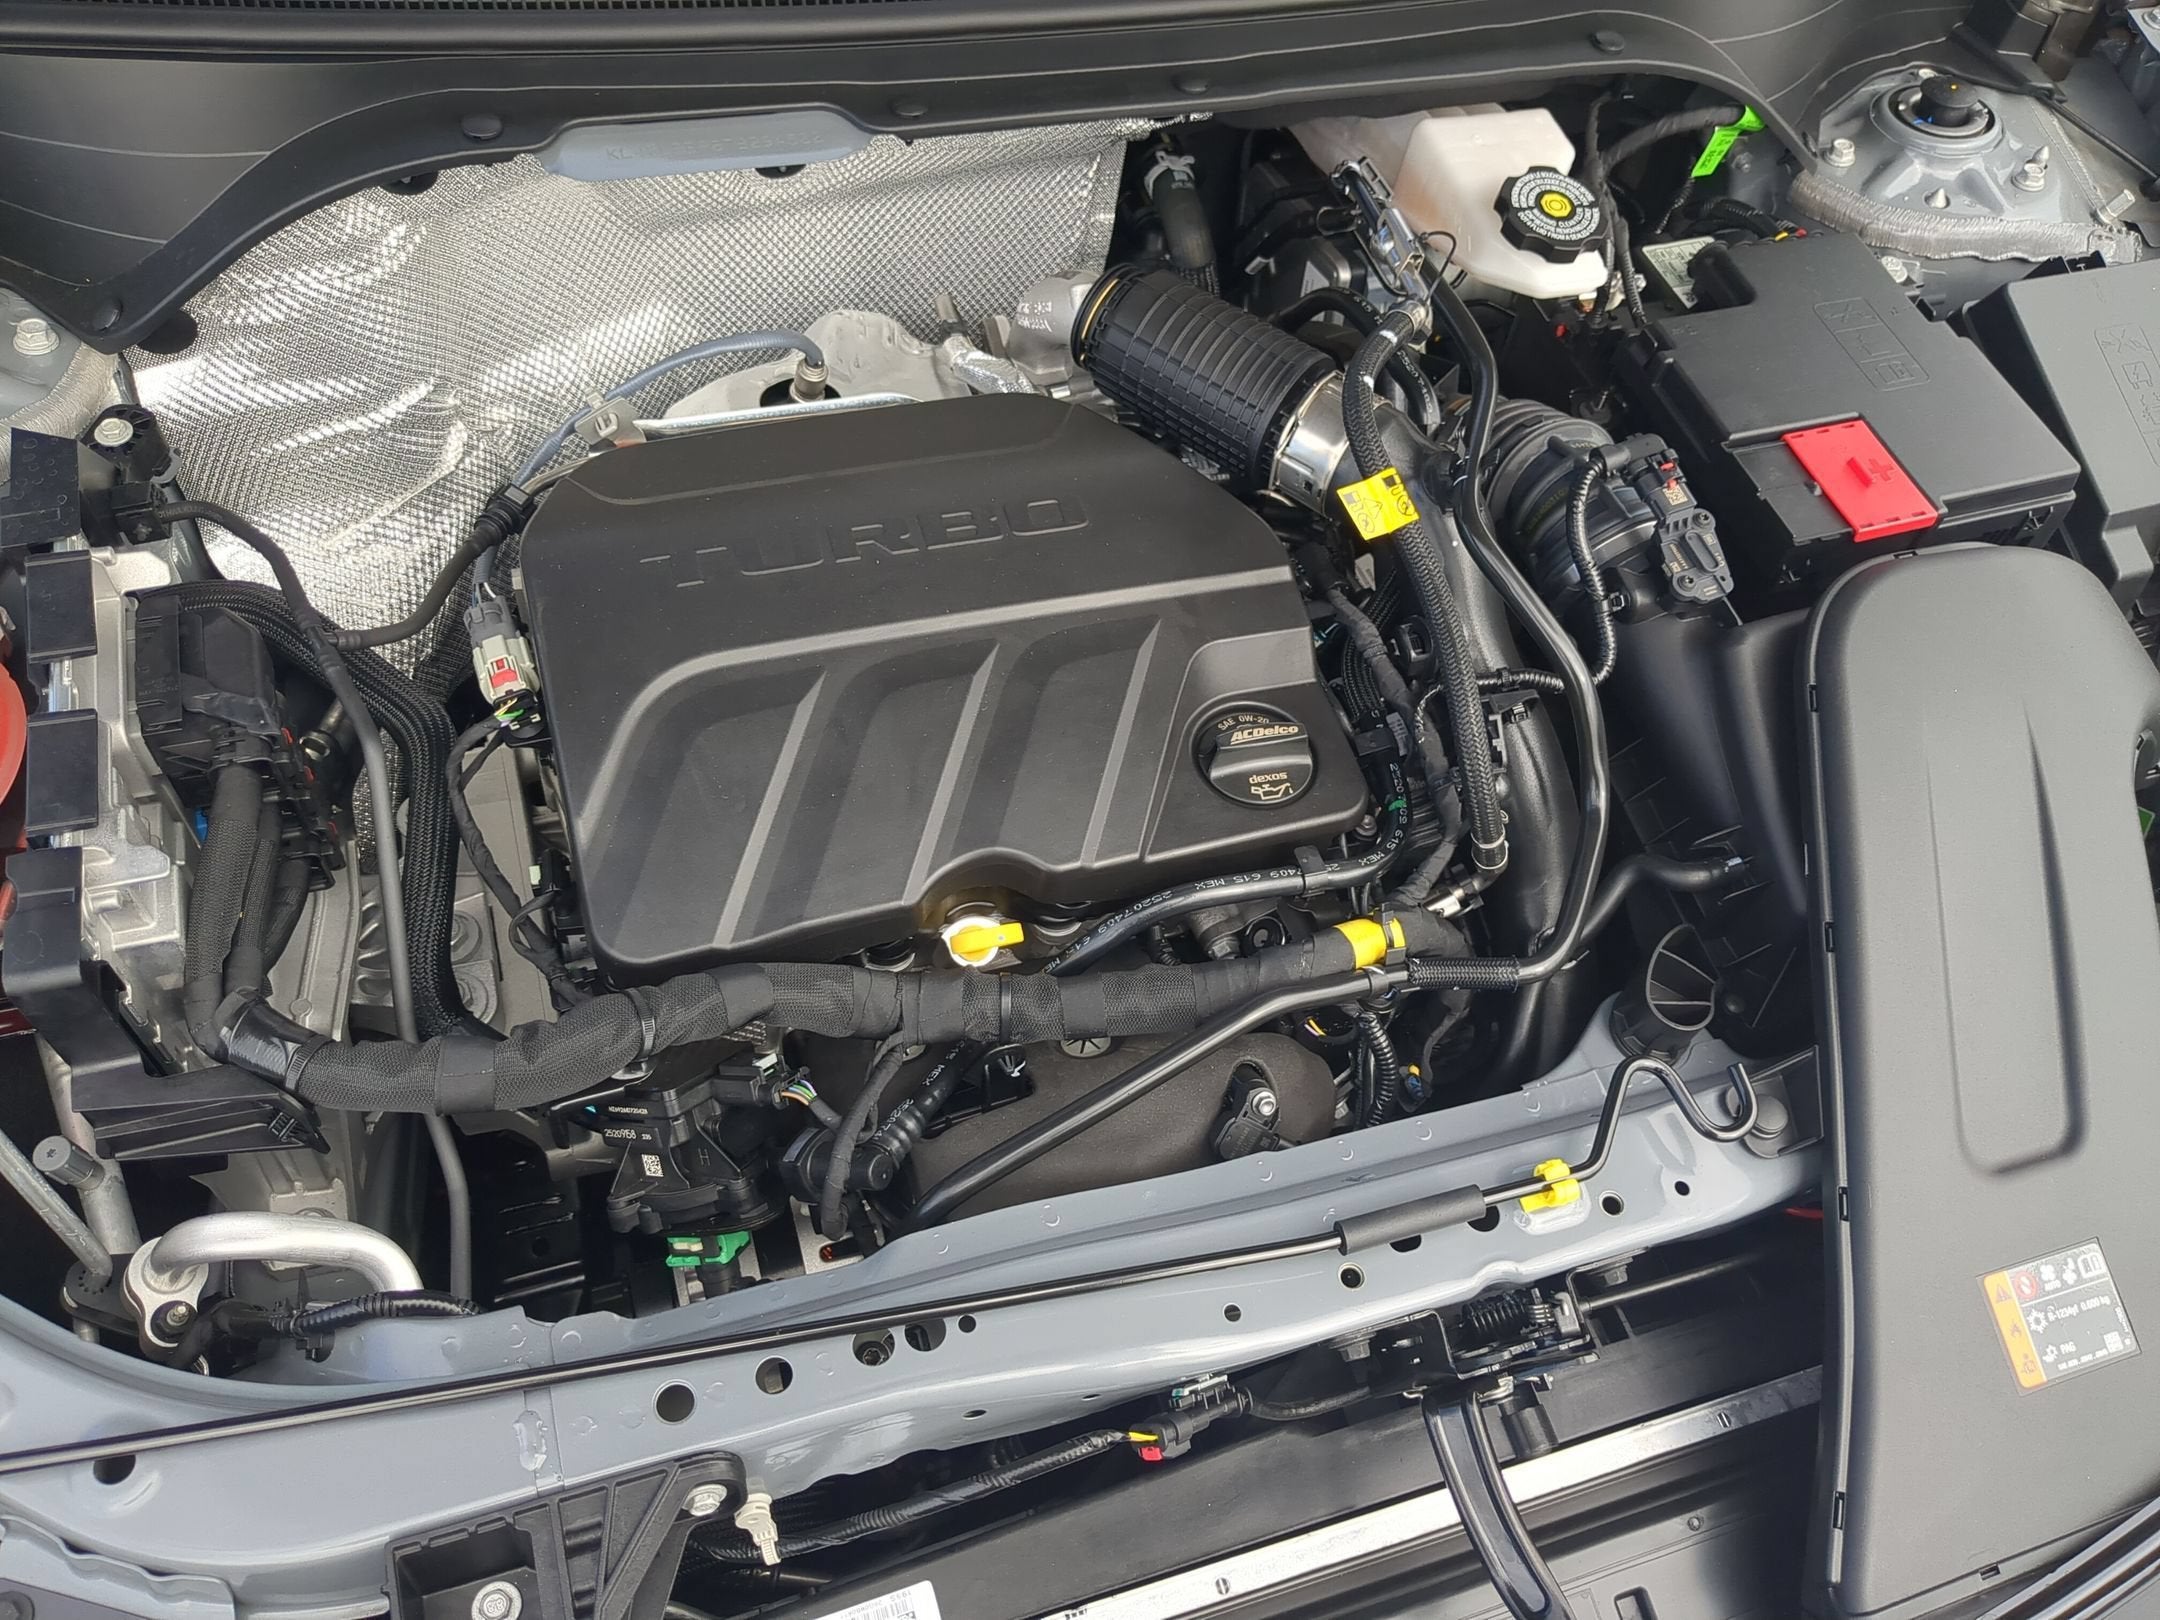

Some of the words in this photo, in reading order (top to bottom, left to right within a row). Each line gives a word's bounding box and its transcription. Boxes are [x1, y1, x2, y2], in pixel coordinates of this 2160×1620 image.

[638, 494, 1090, 588] TURBO
[1218, 717, 1236, 731] SAE
[1230, 725, 1299, 742] ACDelco
[1248, 772, 1288, 784] dexos
[1358, 851, 1386, 867] MEX
[1194, 877, 1226, 891] MEX
[1233, 873, 1261, 885] 615
[1097, 890, 1174, 935] 25207409
[922, 1064, 946, 1086] MEX
